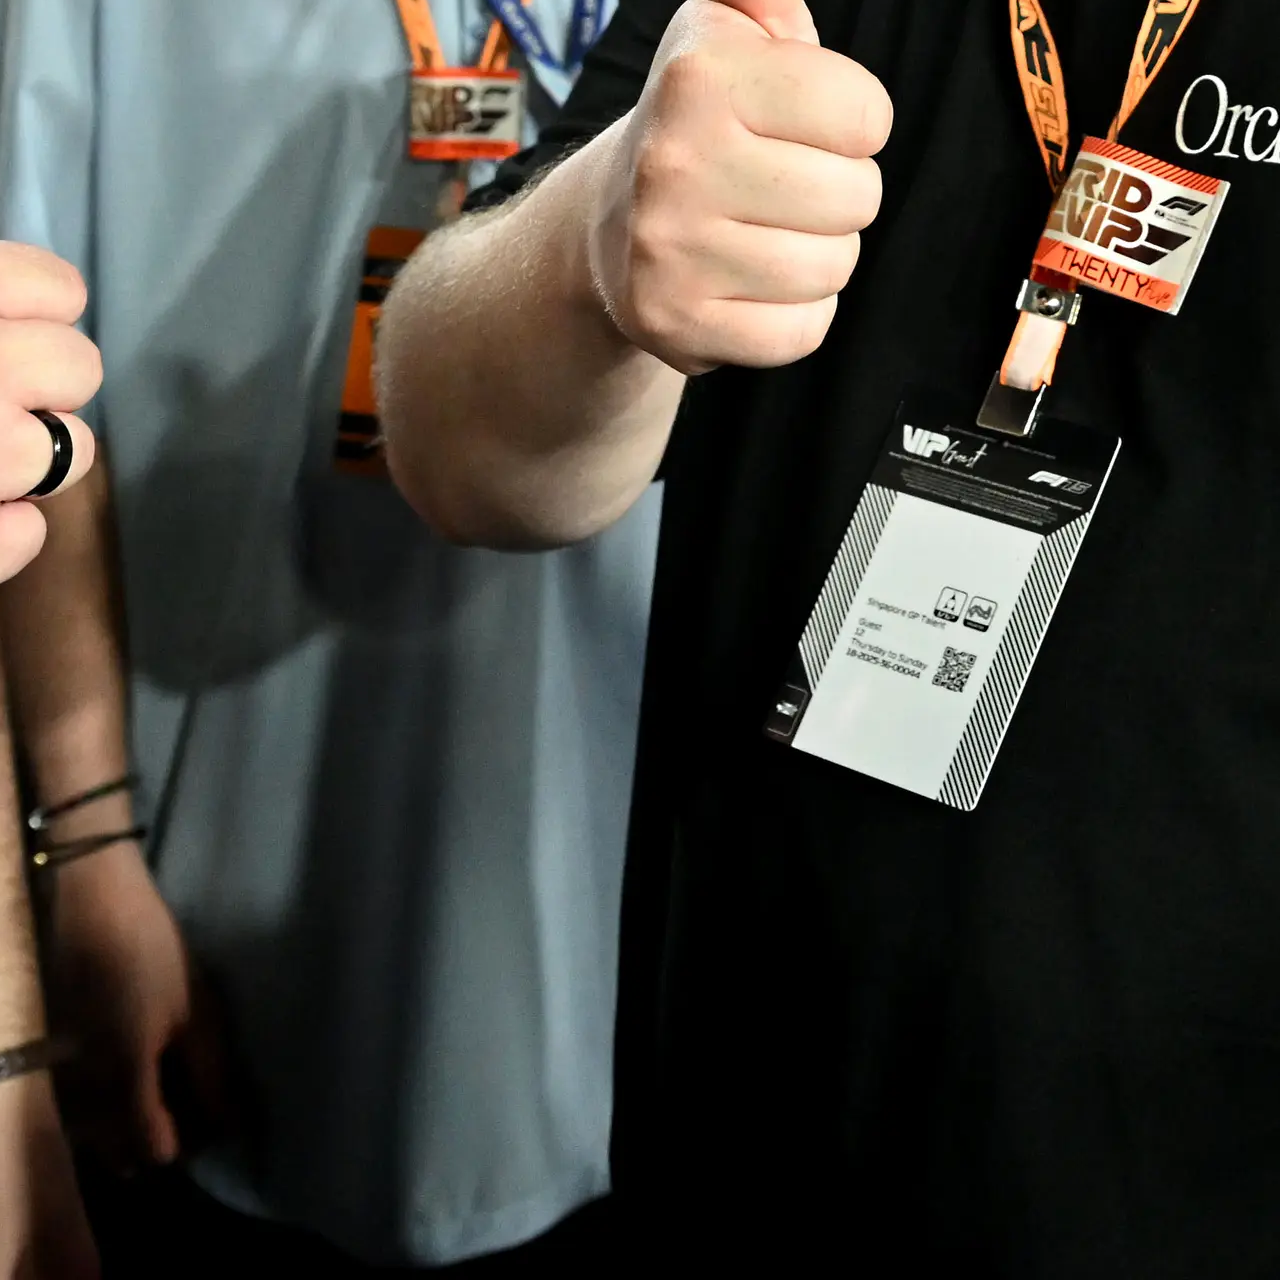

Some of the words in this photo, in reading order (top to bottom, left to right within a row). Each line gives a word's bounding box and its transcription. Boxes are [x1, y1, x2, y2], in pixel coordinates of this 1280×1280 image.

[1058, 246, 1151, 298] TWENTY
[902, 424, 951, 458] VIP
[851, 637, 888, 657] Thursday
[888, 650, 898, 660] to
[898, 654, 928, 671] Sunday
